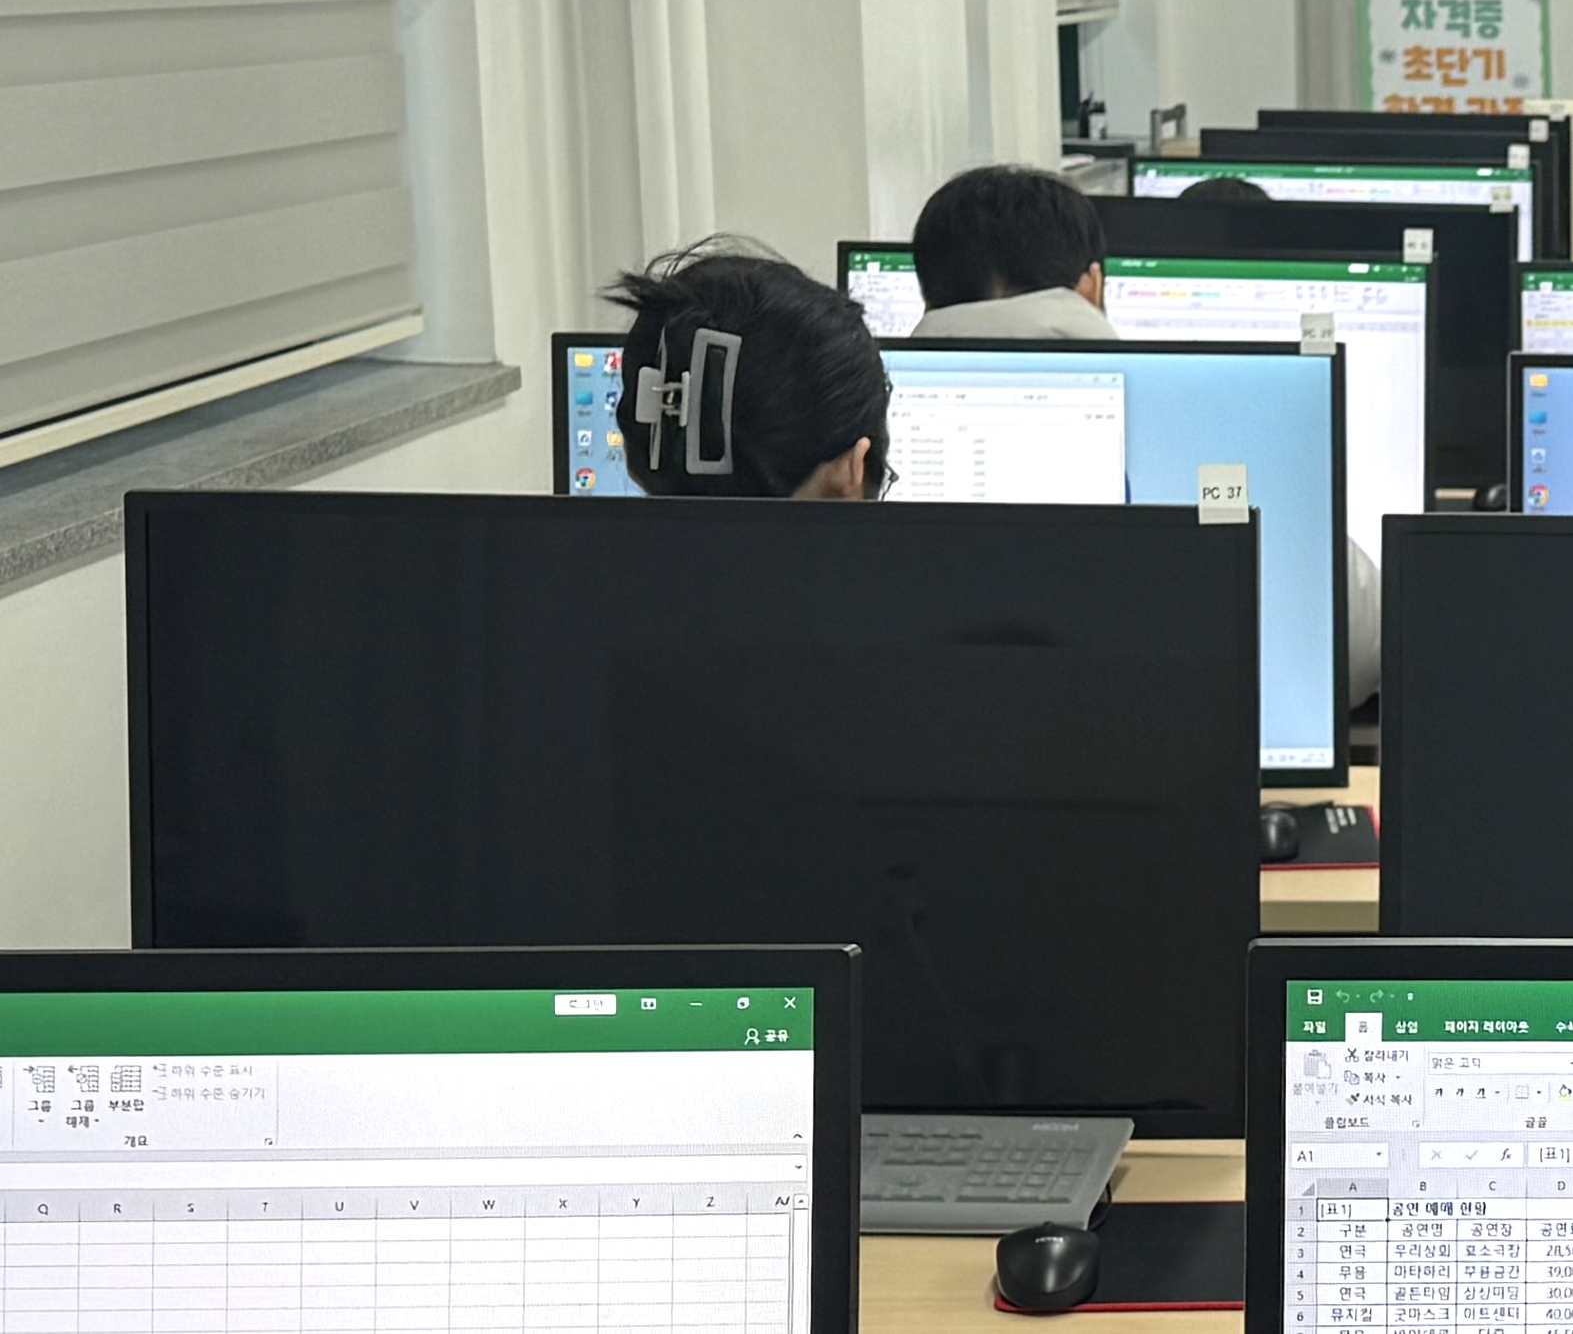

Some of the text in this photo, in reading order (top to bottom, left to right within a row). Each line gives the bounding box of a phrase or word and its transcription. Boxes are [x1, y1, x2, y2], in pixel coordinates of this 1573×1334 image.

[1404, 46, 1506, 87] 초단기
[1202, 486, 1242, 500] PC 37
[1297, 1150, 1313, 1162] A1
[1349, 1182, 1357, 1191] A
[1420, 1182, 1427, 1191] B
[1489, 1181, 1497, 1191] C
[1557, 1181, 1566, 1191] D
[38, 1203, 48, 1215] Q
[113, 1203, 121, 1214] R
[335, 1201, 344, 1212] U
[410, 1201, 419, 1212] V
[482, 1200, 495, 1211] W
[559, 1199, 567, 1209] X
[706, 1197, 715, 1207] Z
[1297, 1228, 1304, 1237] 2
[1339, 1224, 1366, 1238] 구분
[1402, 1223, 1443, 1237] 공연명
[1339, 1245, 1366, 1259] 연극
[1297, 1270, 1304, 1279] 4
[1297, 1290, 1304, 1300] 5
[1339, 1287, 1366, 1301] 연극
[1297, 1312, 1304, 1322] 6
